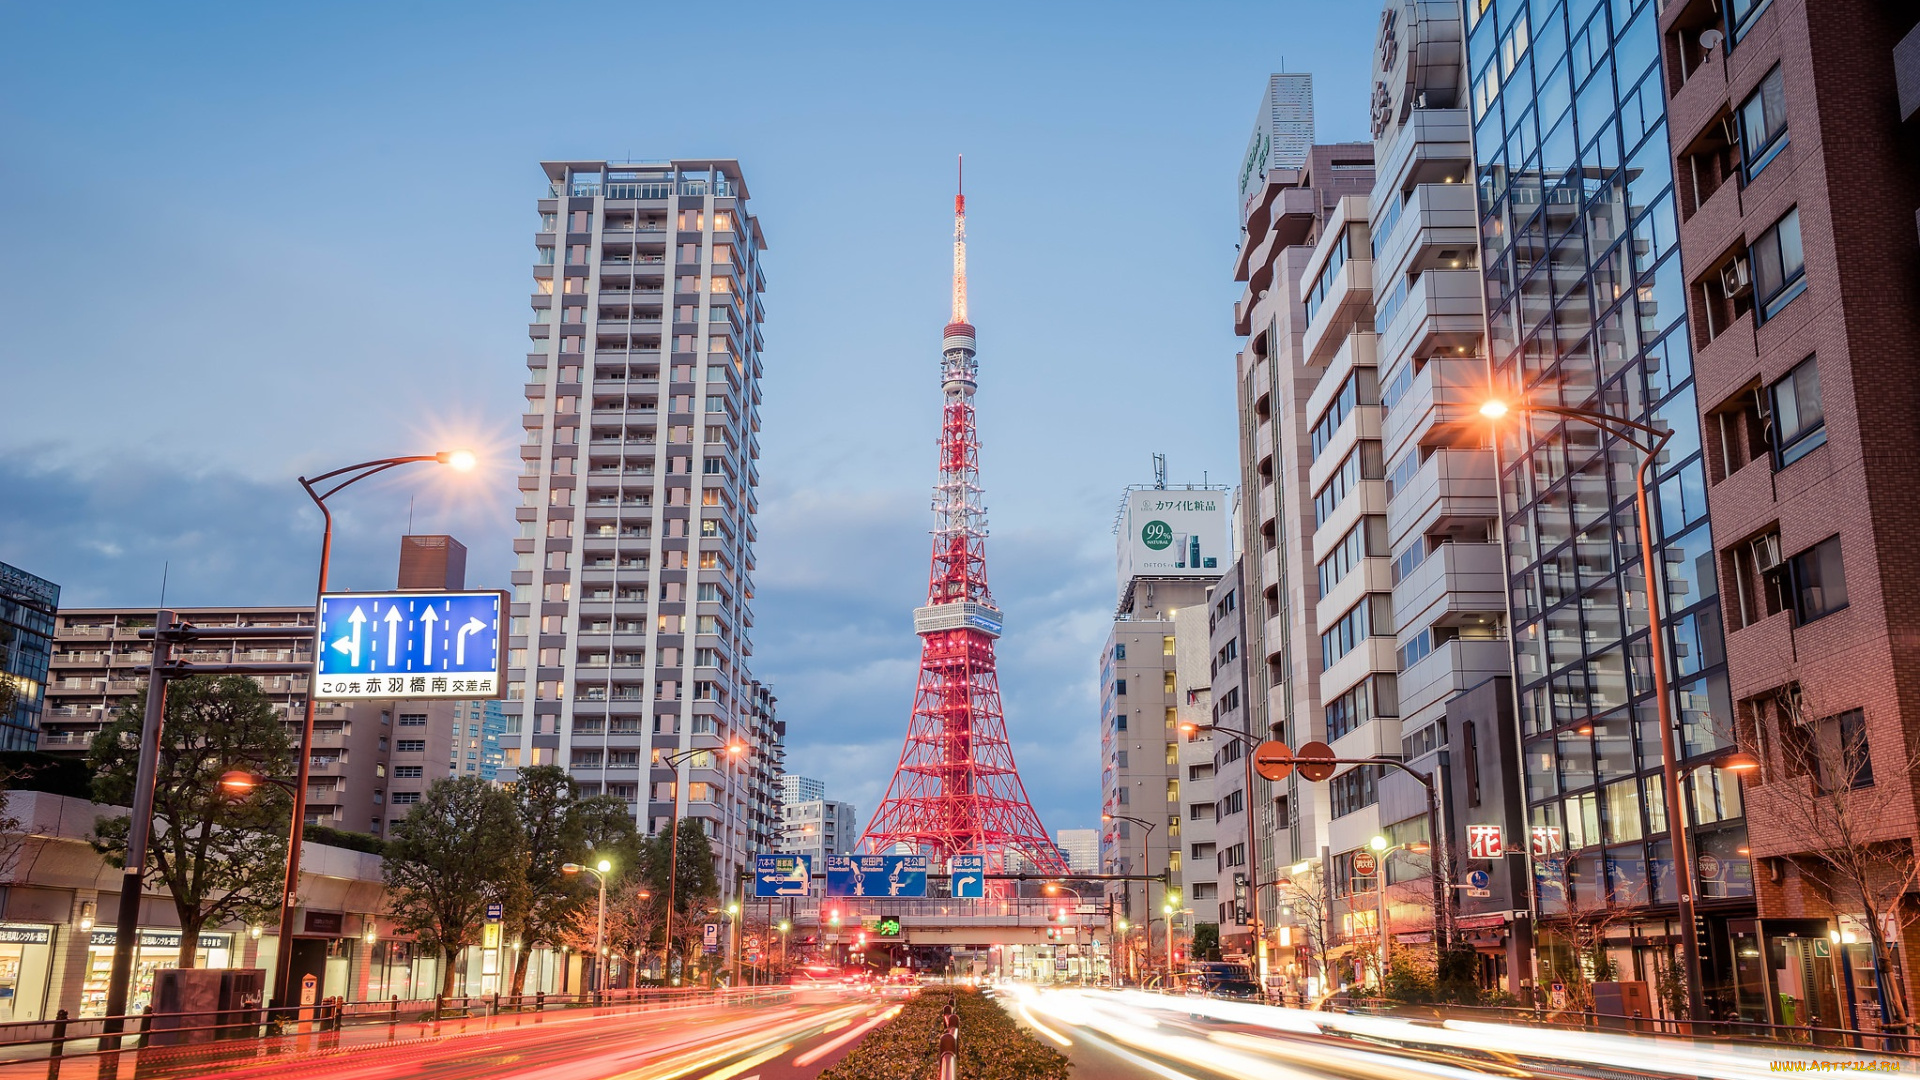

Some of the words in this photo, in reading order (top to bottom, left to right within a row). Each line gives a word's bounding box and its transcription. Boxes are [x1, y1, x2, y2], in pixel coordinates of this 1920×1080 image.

[1155, 500, 1216, 512] カワイ化粧品
[1146, 524, 1171, 541] 99%
[1472, 828, 1501, 856] 花
[757, 858, 775, 867] 六本木
[828, 857, 850, 866] 日本橋
[861, 857, 884, 866] 桜田門
[903, 857, 926, 866] 芝公園
[953, 857, 982, 867] 金杉橋
[1356, 860, 1374, 869] 消火栓
[706, 925, 715, 936] P
[0, 931, 48, 942] 祉用具レンタル・販売
